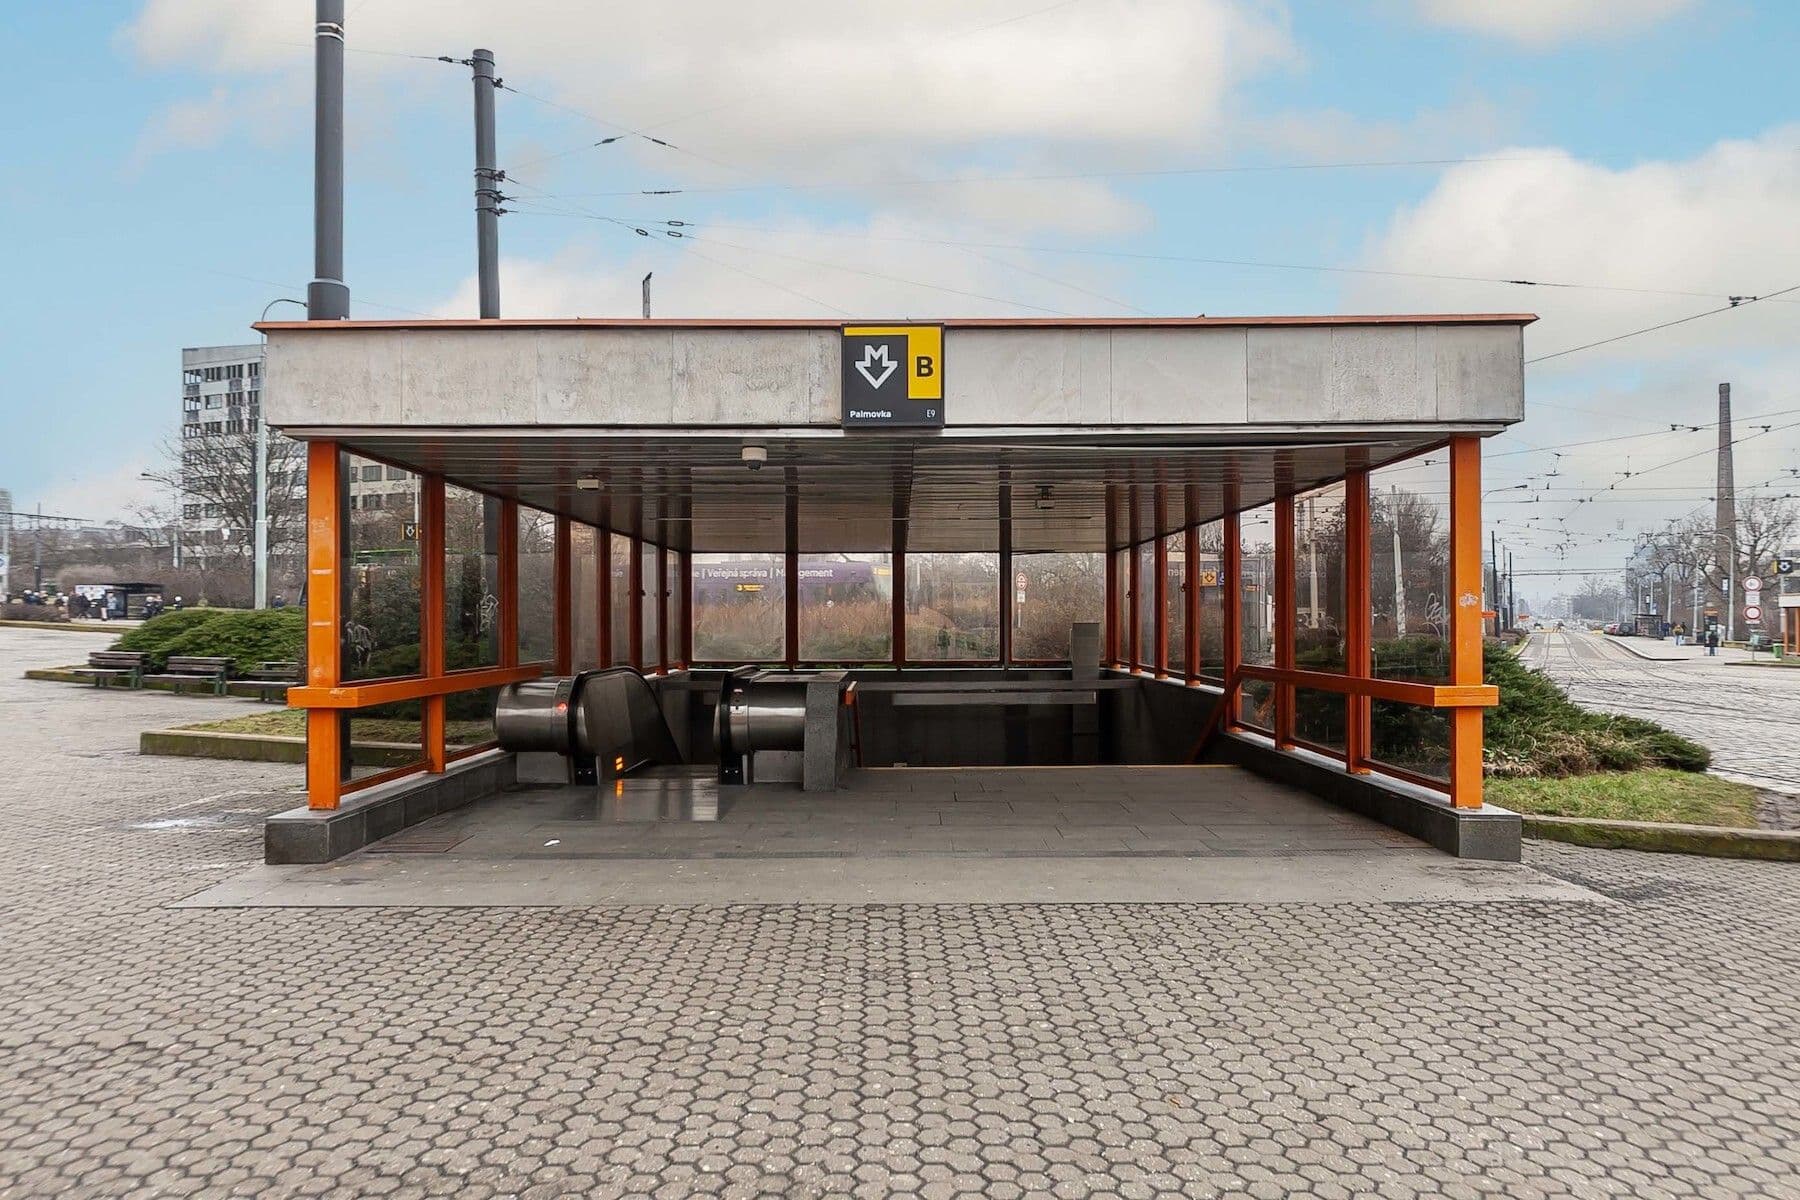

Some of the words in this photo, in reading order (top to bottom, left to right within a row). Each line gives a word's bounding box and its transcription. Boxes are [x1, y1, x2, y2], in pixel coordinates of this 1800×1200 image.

[916, 355, 934, 377] B
[849, 410, 892, 418] Palmovka
[926, 409, 936, 418] E9
